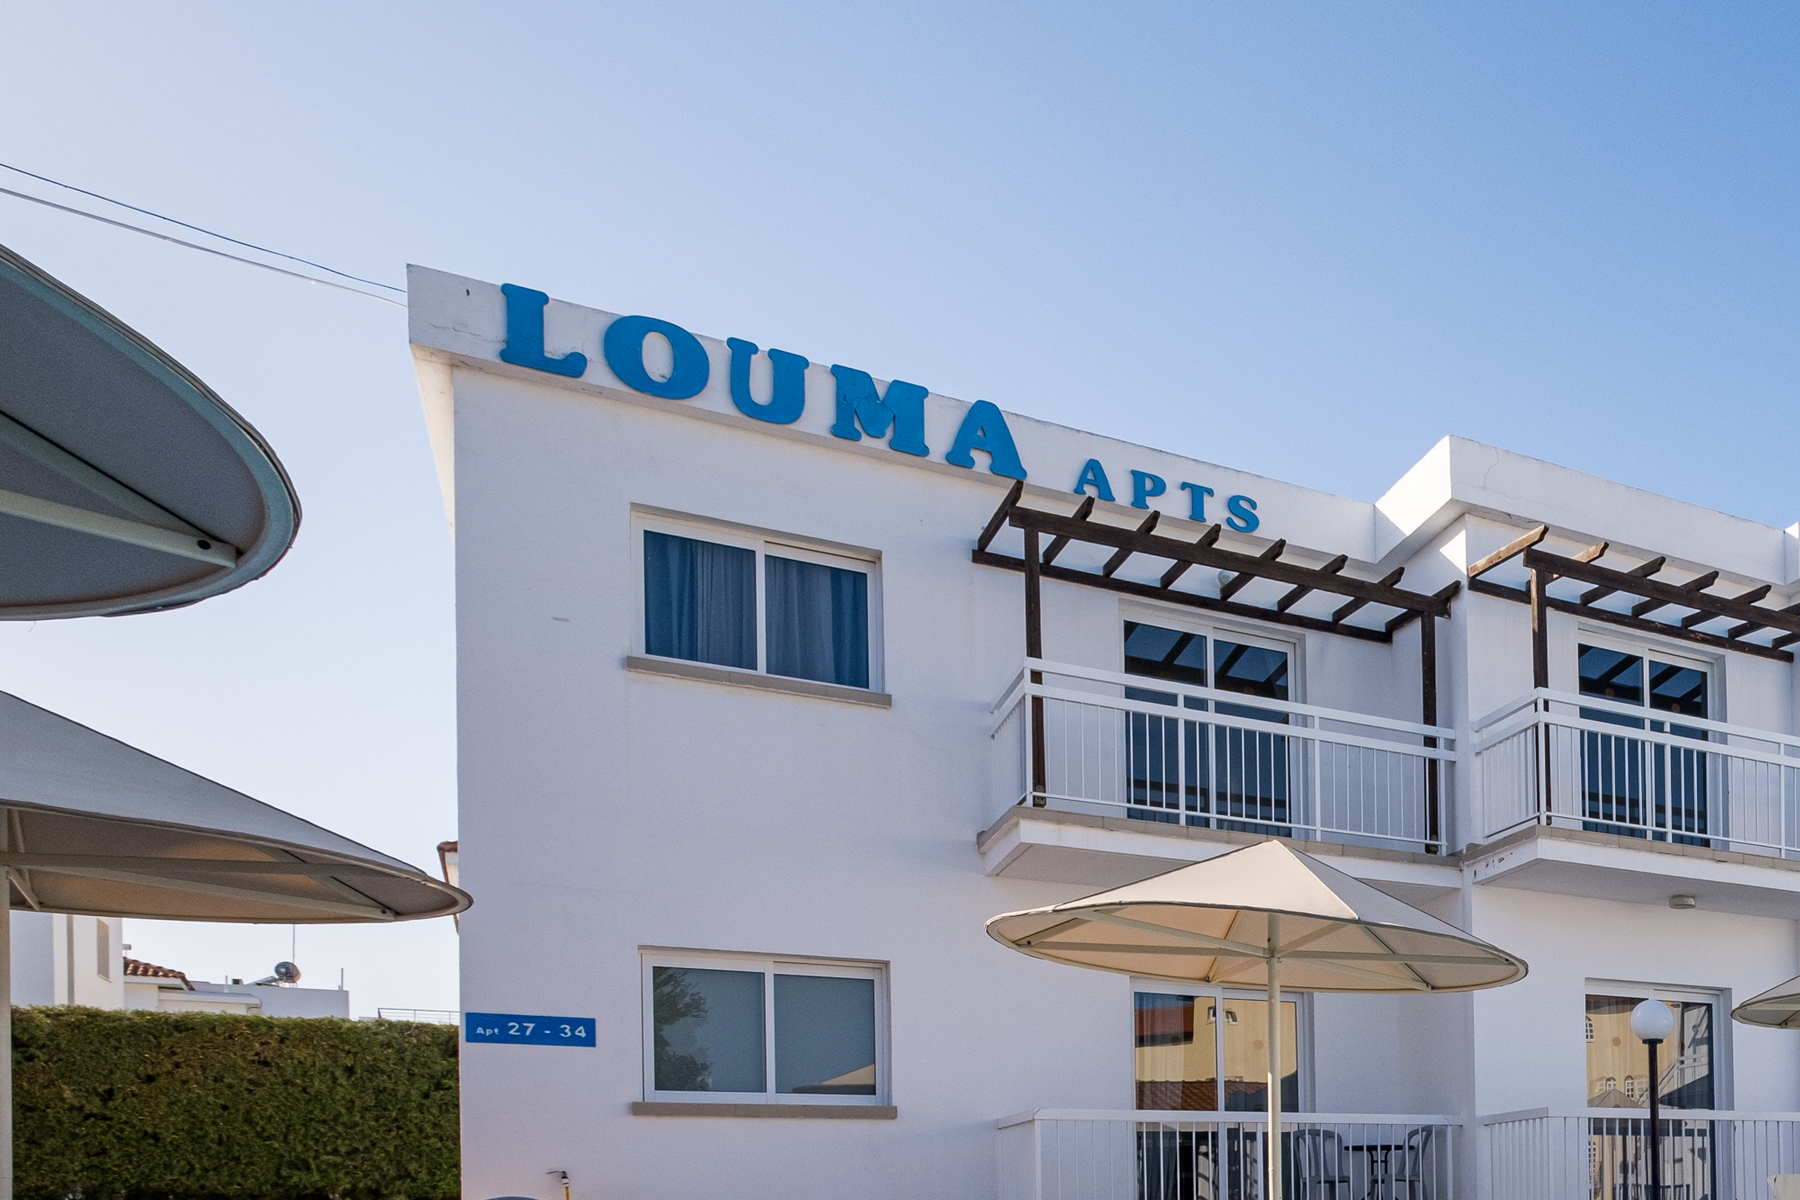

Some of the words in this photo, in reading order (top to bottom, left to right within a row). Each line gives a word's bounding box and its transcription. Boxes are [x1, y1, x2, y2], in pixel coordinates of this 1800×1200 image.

[500, 282, 1028, 481] LOUMA
[1073, 458, 1261, 533] APTS
[476, 1026, 499, 1036] Apt
[507, 1022, 535, 1036] 27
[559, 1024, 586, 1038] 34
